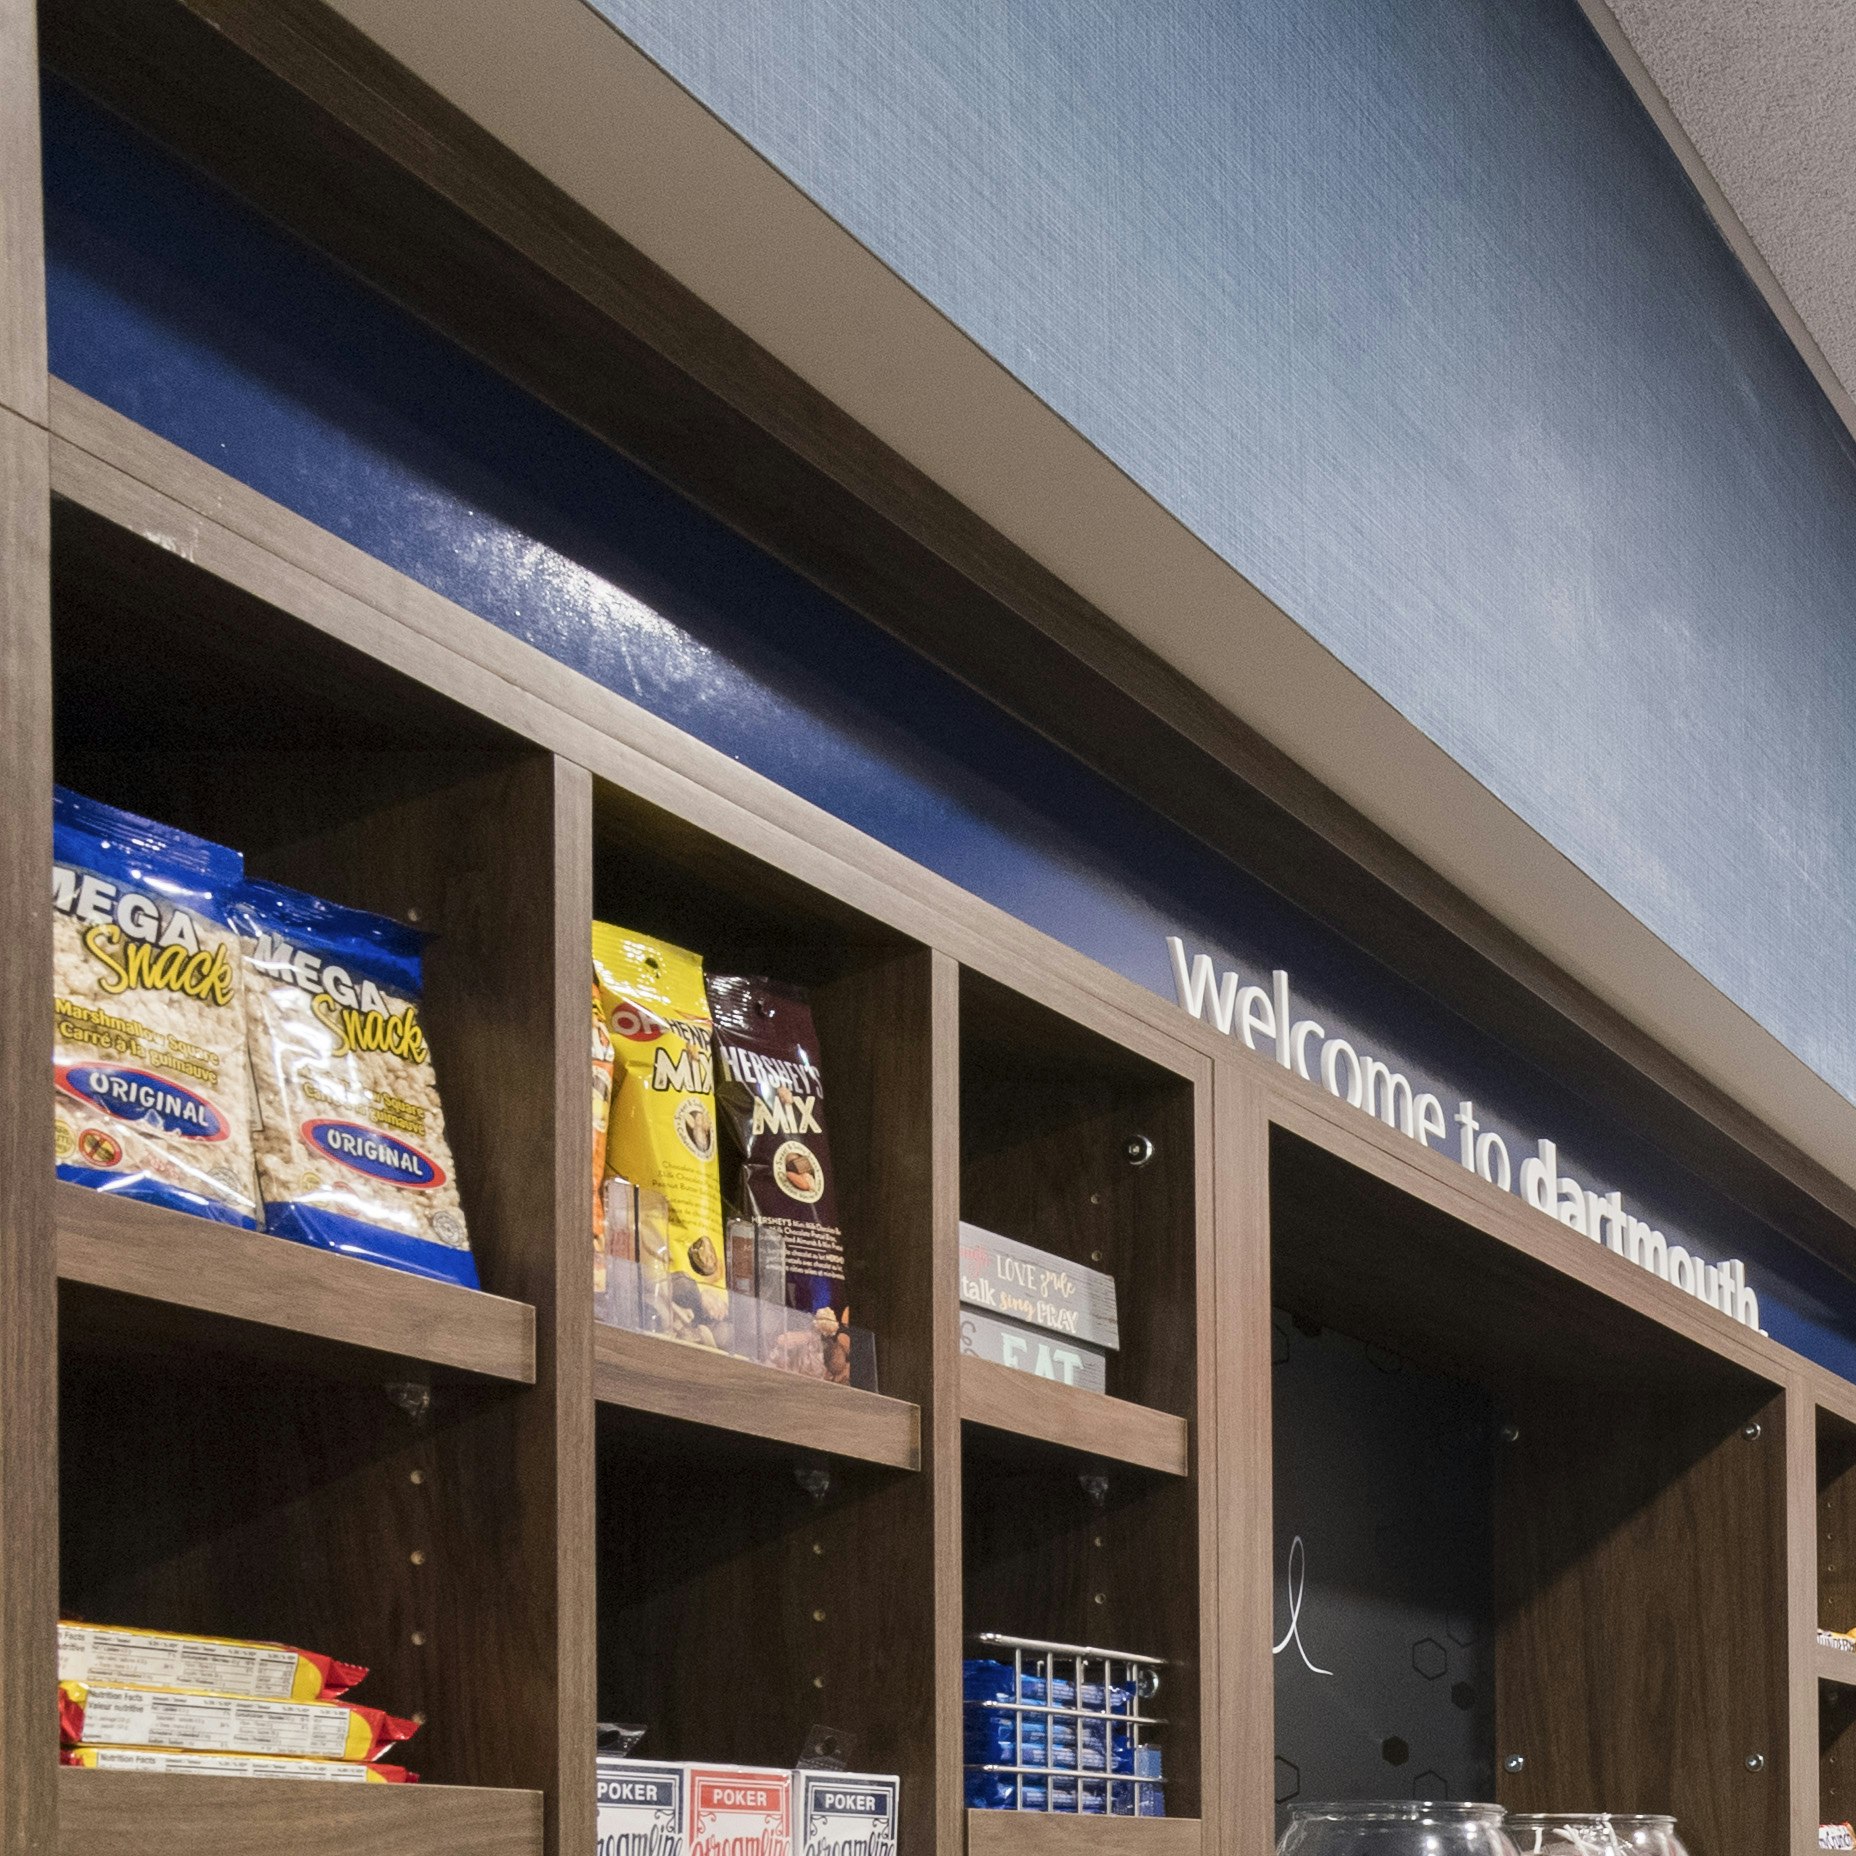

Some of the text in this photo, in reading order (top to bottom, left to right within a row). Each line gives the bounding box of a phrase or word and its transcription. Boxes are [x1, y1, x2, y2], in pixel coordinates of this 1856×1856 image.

[83, 924, 234, 1006] Snack
[251, 933, 390, 1013] MEGA
[55, 997, 219, 1065] Marshmallow Square
[60, 1021, 218, 1084] Carré guimauve
[311, 994, 428, 1063] Snack
[652, 1047, 713, 1095] MIX
[720, 1045, 823, 1099] HERSHEY'S
[89, 1071, 209, 1127] ORIGINAL
[753, 1095, 822, 1136] MIX
[327, 1129, 423, 1177] ORIGINAL
[1166, 936, 1769, 1338] welcome to dartmouth.
[996, 1254, 1037, 1290] LOVE
[962, 1276, 1078, 1333] talk PRAY
[597, 1782, 657, 1801] POKER
[713, 1789, 767, 1806] POKER
[825, 1794, 875, 1811] POKER
